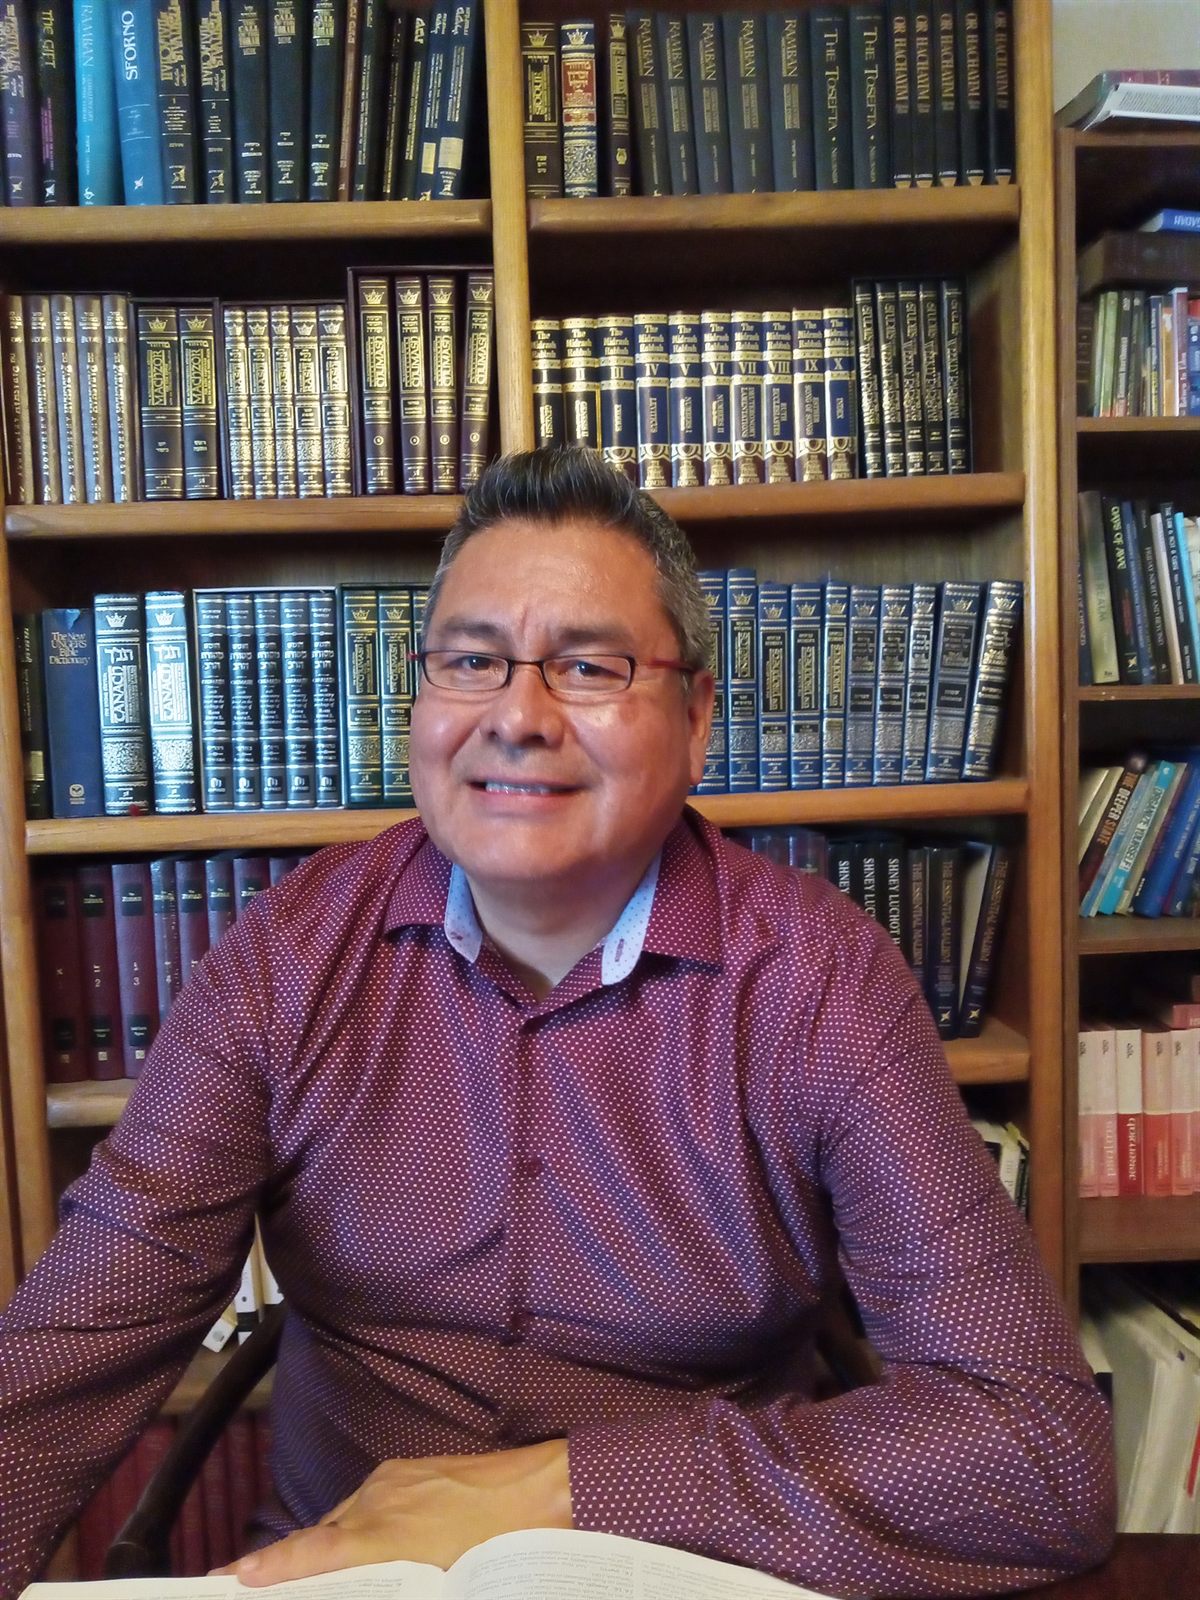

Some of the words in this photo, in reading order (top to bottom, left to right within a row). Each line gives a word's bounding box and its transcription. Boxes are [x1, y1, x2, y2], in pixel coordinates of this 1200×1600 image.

[893, 16, 906, 34] OR
[916, 15, 928, 33] OR
[941, 13, 953, 31] OR
[965, 13, 978, 30] OR
[81, 4, 94, 67] RAMBAN
[121, 10, 139, 81] SFORNO
[639, 18, 654, 77] RAMBAN
[669, 21, 684, 80] RAMBAN
[742, 19, 756, 78] RAMBAN
[784, 19, 798, 77] RAMBAN
[824, 28, 838, 63] THE
[863, 27, 878, 61] THE
[702, 22, 717, 81] RAMBAN
[825, 66, 839, 131] TOSEFTA
[864, 64, 878, 129] TOSEFTA
[644, 325, 658, 333] The
[677, 325, 692, 333] The
[709, 324, 724, 332] The
[741, 323, 755, 331] The
[773, 322, 786, 331] The
[803, 321, 817, 329] The
[536, 331, 551, 339] The
[571, 329, 586, 338] The
[609, 328, 624, 336] The
[638, 334, 664, 343] Midrash
[704, 333, 729, 341] Midrash
[735, 332, 760, 341] Midrash
[766, 332, 791, 340] Midrash
[798, 330, 822, 339] Midrash
[566, 339, 592, 348] Midrash
[603, 337, 629, 346] Midrash
[672, 335, 697, 343] Midrash
[735, 341, 759, 350] Rabbah
[767, 341, 790, 350] Rabbah
[799, 340, 822, 348] Rabbah
[567, 348, 592, 357] Rabbah
[604, 347, 629, 355] Rabbah
[639, 343, 664, 352] Rabbah
[673, 344, 697, 353] Rabbah
[705, 342, 729, 351] Rabbah
[644, 363, 659, 376] IV
[680, 364, 690, 376] V
[709, 362, 724, 374] VI
[739, 361, 757, 374] VII
[768, 361, 790, 373] VIII
[804, 359, 819, 371] IX
[833, 358, 843, 370] X
[542, 370, 548, 382] I
[575, 368, 586, 381] II
[610, 366, 624, 379] III
[740, 386, 749, 438] LAMENTATIONS
[748, 386, 756, 438] DEUTERONOMY
[771, 388, 781, 436] ECCLESIASTES
[836, 397, 844, 419] INDEX
[805, 414, 813, 436] SONGS
[1110, 506, 1122, 530] DAYS
[1113, 533, 1124, 546] OF
[1115, 547, 1127, 570] AWE
[51, 632, 67, 640] The
[67, 632, 86, 640] New
[59, 648, 79, 656] Bible
[49, 655, 89, 665] Dictionary
[1124, 772, 1139, 789] THE
[1108, 787, 1131, 820] DEEPER
[1097, 819, 1116, 846] STATE
[863, 857, 875, 891] SHNEY
[887, 858, 899, 891] SHNEY
[912, 863, 922, 880] THE
[942, 861, 953, 878] THE
[838, 860, 849, 893] SHNEY
[912, 882, 922, 928] ESSENTIAL
[941, 879, 952, 924] ESSENTIAL
[888, 894, 900, 936] LUCHOT
[94, 979, 101, 988] 2
[133, 977, 140, 985] 3
[1103, 1120, 1117, 1178] psalms
